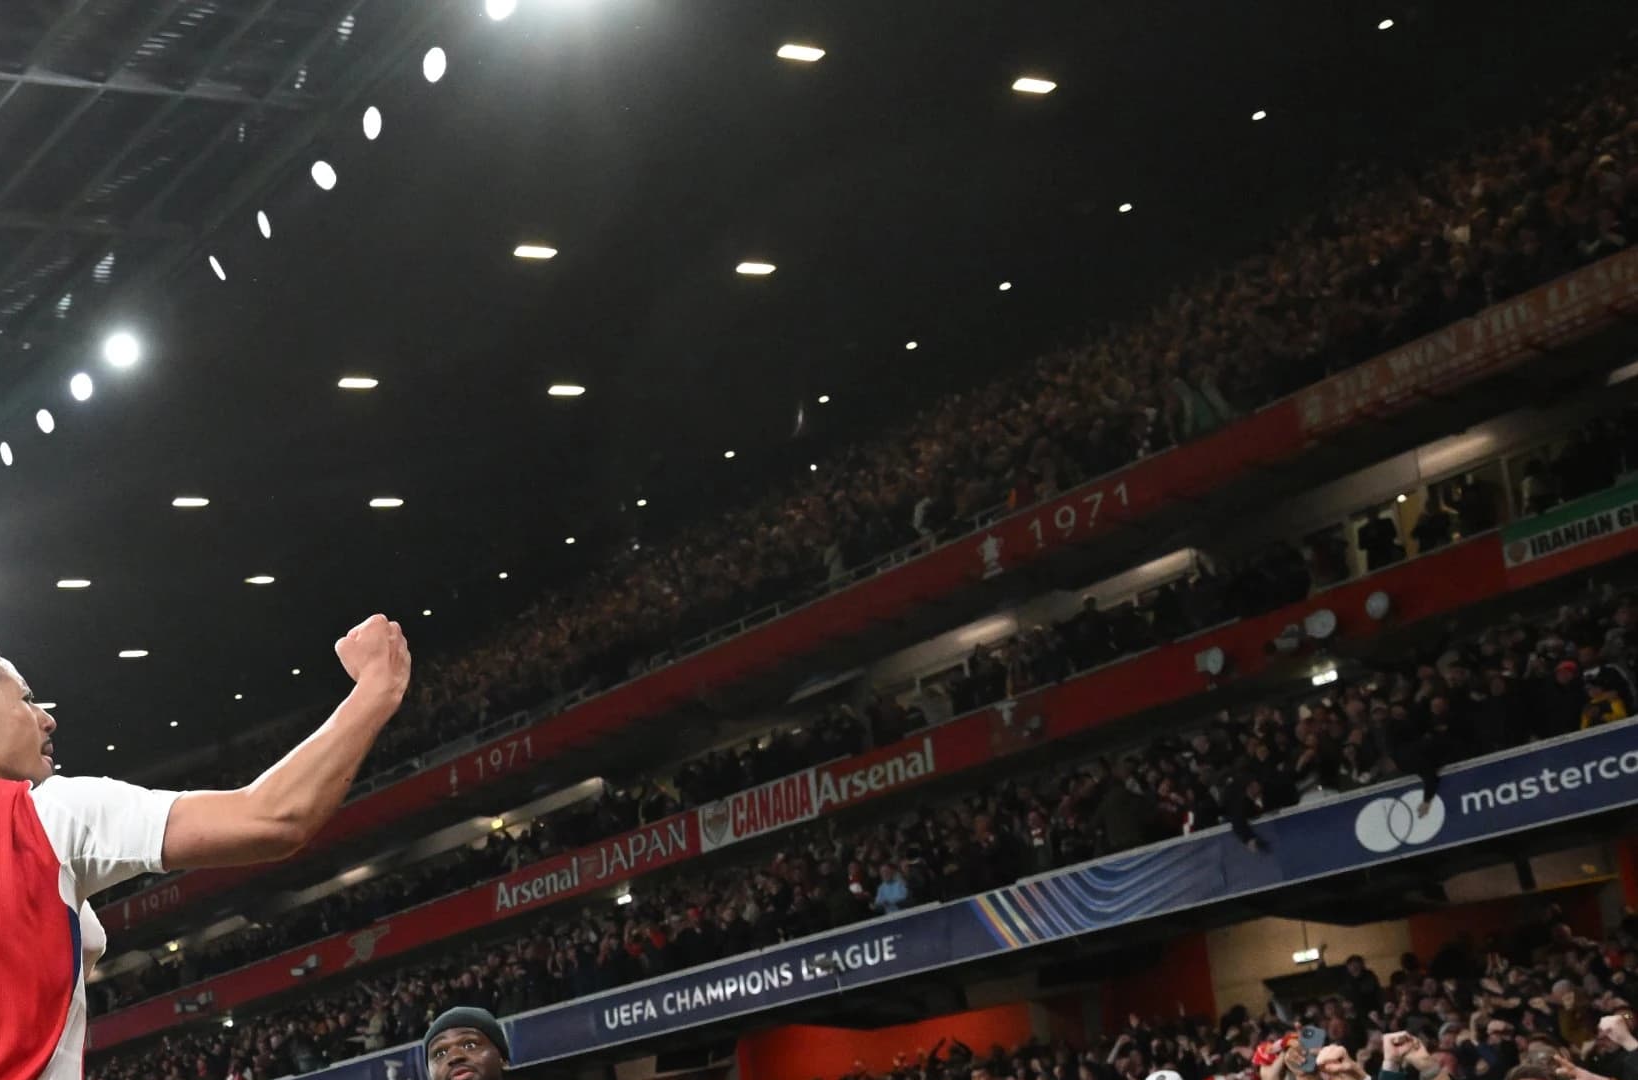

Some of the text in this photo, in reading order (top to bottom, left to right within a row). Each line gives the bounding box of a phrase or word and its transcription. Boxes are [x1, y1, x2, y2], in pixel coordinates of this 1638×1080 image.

[1027, 480, 1128, 548] 1971
[1530, 512, 1612, 556] IRANIAN
[474, 735, 531, 779] 1971
[818, 737, 935, 809] Arsenal
[732, 772, 810, 838] CANADA
[495, 819, 687, 912] Arsenal JAPAN
[604, 936, 898, 1030] UEFA CHAMPIONS LEAGUE
